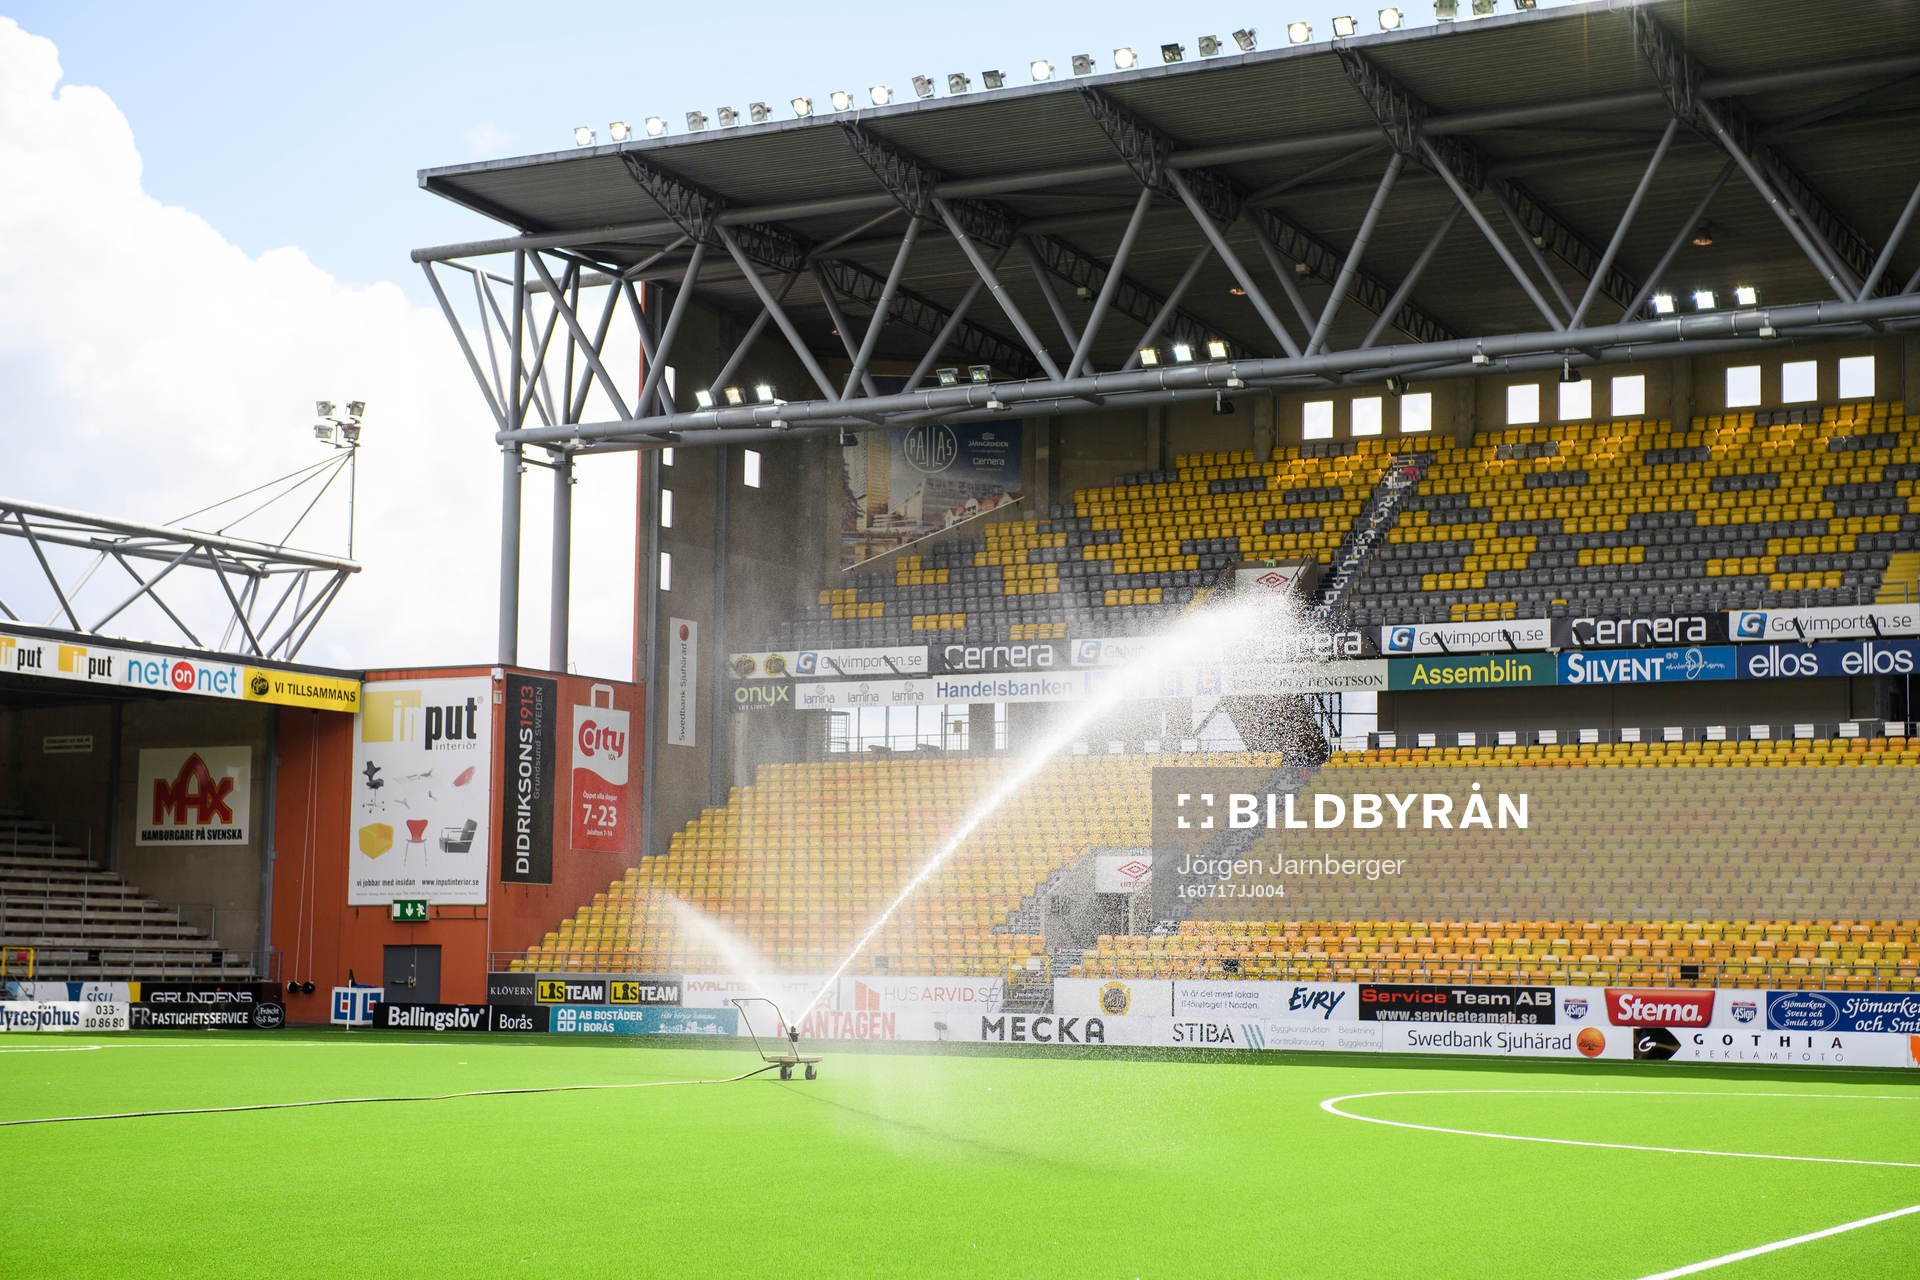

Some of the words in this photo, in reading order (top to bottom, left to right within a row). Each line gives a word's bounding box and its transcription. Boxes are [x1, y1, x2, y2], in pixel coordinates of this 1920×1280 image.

[909, 427, 953, 468] PALLAS
[1567, 652, 1665, 684] SILVENT
[1749, 645, 1819, 677] ellos
[1841, 642, 1914, 675] ellos
[1411, 659, 1532, 686] Assemblin
[275, 681, 285, 694] VI
[288, 683, 357, 702] TILLSAMMANS
[735, 685, 790, 706] onyx
[936, 679, 1073, 698] Handelsbanken
[435, 740, 477, 751] interior
[578, 719, 625, 758] City
[152, 752, 234, 825] MAX
[582, 803, 618, 827] 7-23
[141, 829, 194, 841] HAMBURGARE
[196, 827, 206, 841] PÅ
[207, 829, 243, 841] SVENSKA
[382, 879, 394, 887] med
[395, 878, 415, 886] insidan
[151, 991, 253, 1004] GRUNDENS
[1361, 988, 1447, 1005] Service
[1451, 990, 1511, 1006] Team
[1516, 991, 1552, 1007] AB
[1781, 1000, 1826, 1010] Sjömarkens
[578, 1010, 592, 1020] AB
[594, 1010, 643, 1021] BOSTÄDER
[1376, 1008, 1537, 1024] www.serviceteamab.se
[1808, 1009, 1823, 1018] och
[1842, 997, 1920, 1018] Sjömarke
[85, 1018, 97, 1028] 10
[98, 1018, 111, 1028] 86
[112, 1018, 125, 1028] 80
[152, 1012, 248, 1025] FASTIGHETSSERVICE
[500, 1014, 533, 1030] Borås
[583, 1021, 615, 1033] BORÅS
[777, 1011, 896, 1040] ANTAGEN
[1783, 1019, 1809, 1027] Smide
[1809, 1019, 1825, 1027] AB
[1855, 1015, 1885, 1031] och
[981, 1015, 1105, 1043] MECKA
[1172, 1023, 1235, 1043] STIBA
[1408, 1029, 1493, 1048] Swedbank
[1496, 1031, 1572, 1054] Sjuhärad
[1693, 1033, 1843, 1049] GOTHIA
[1694, 1050, 1844, 1062] REKLAMFOTO
